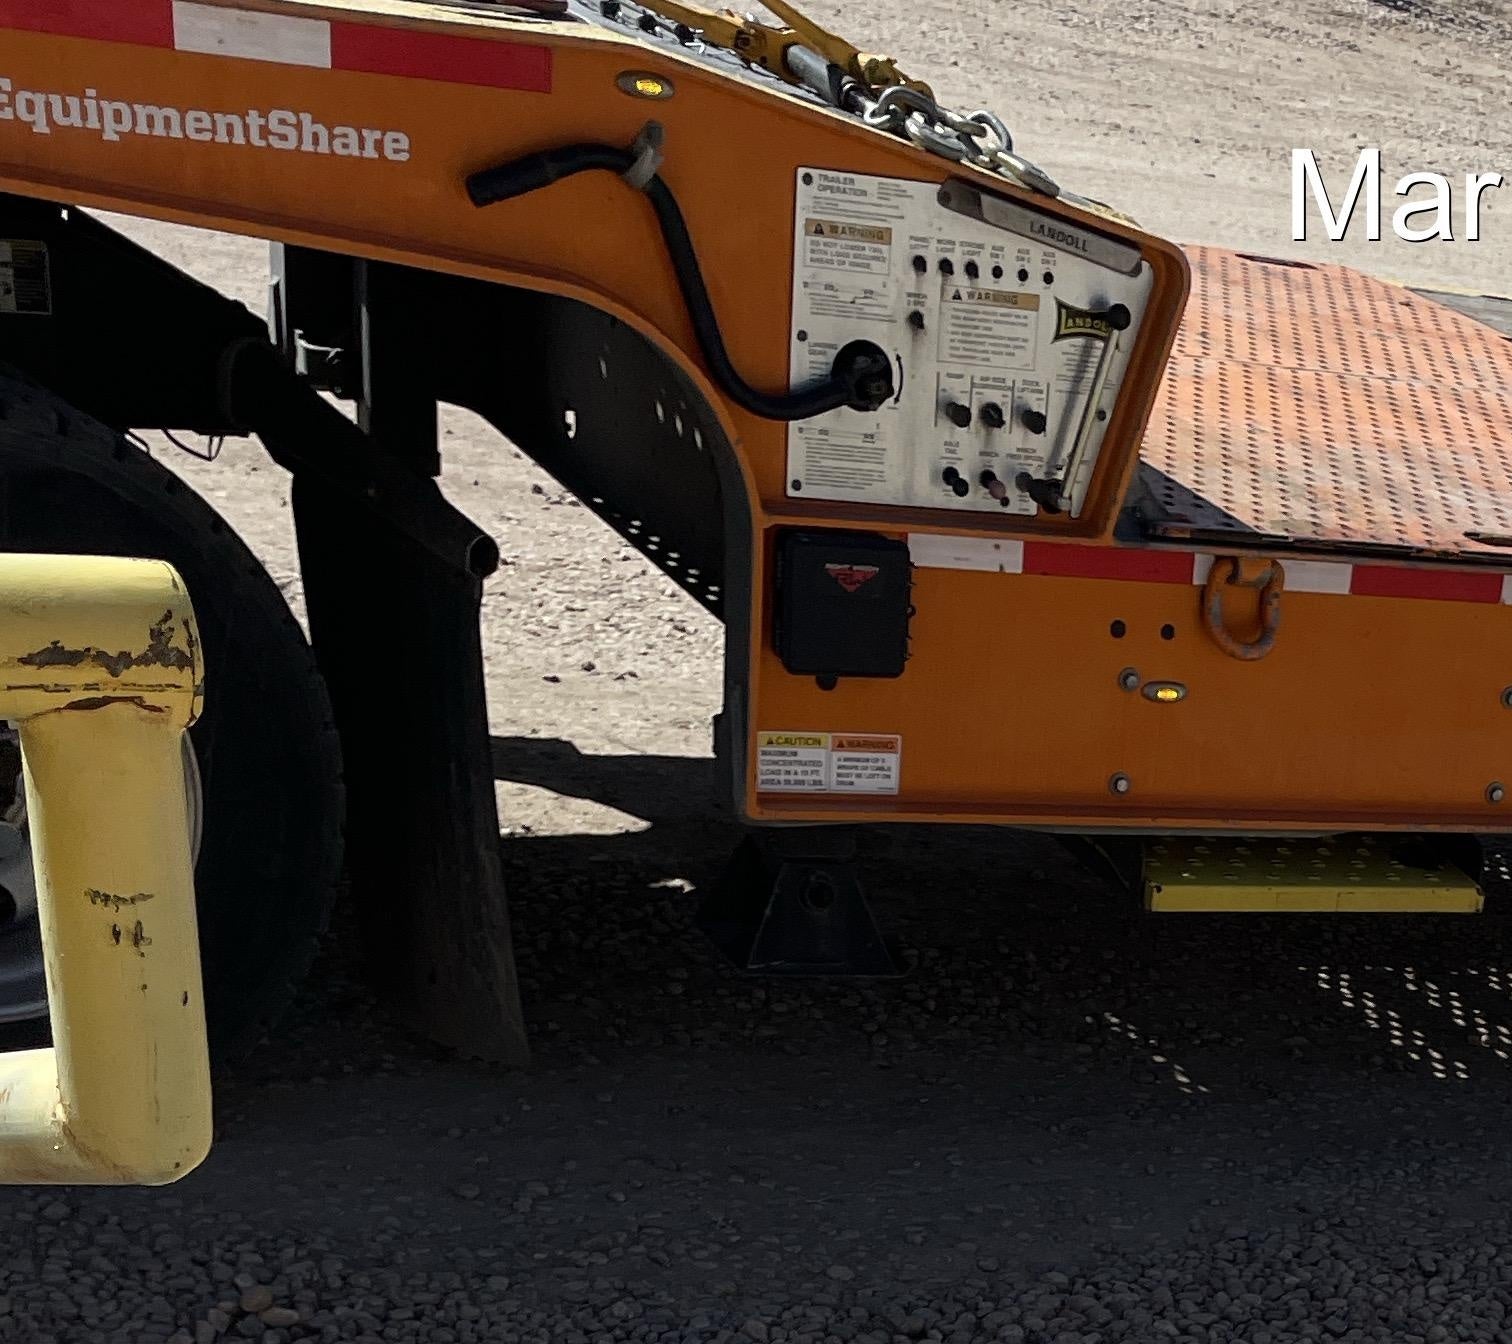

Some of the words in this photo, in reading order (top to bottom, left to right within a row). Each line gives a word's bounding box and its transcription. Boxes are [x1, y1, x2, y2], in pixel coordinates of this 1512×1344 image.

[817, 173, 855, 186] TRAILER
[817, 184, 868, 197] OPERATION
[829, 224, 885, 241] WARNING
[1029, 220, 1090, 252] LANDOLL
[966, 289, 1019, 306] WARNING
[1060, 308, 1109, 337] LANDOL
[775, 735, 822, 747] CAUTION
